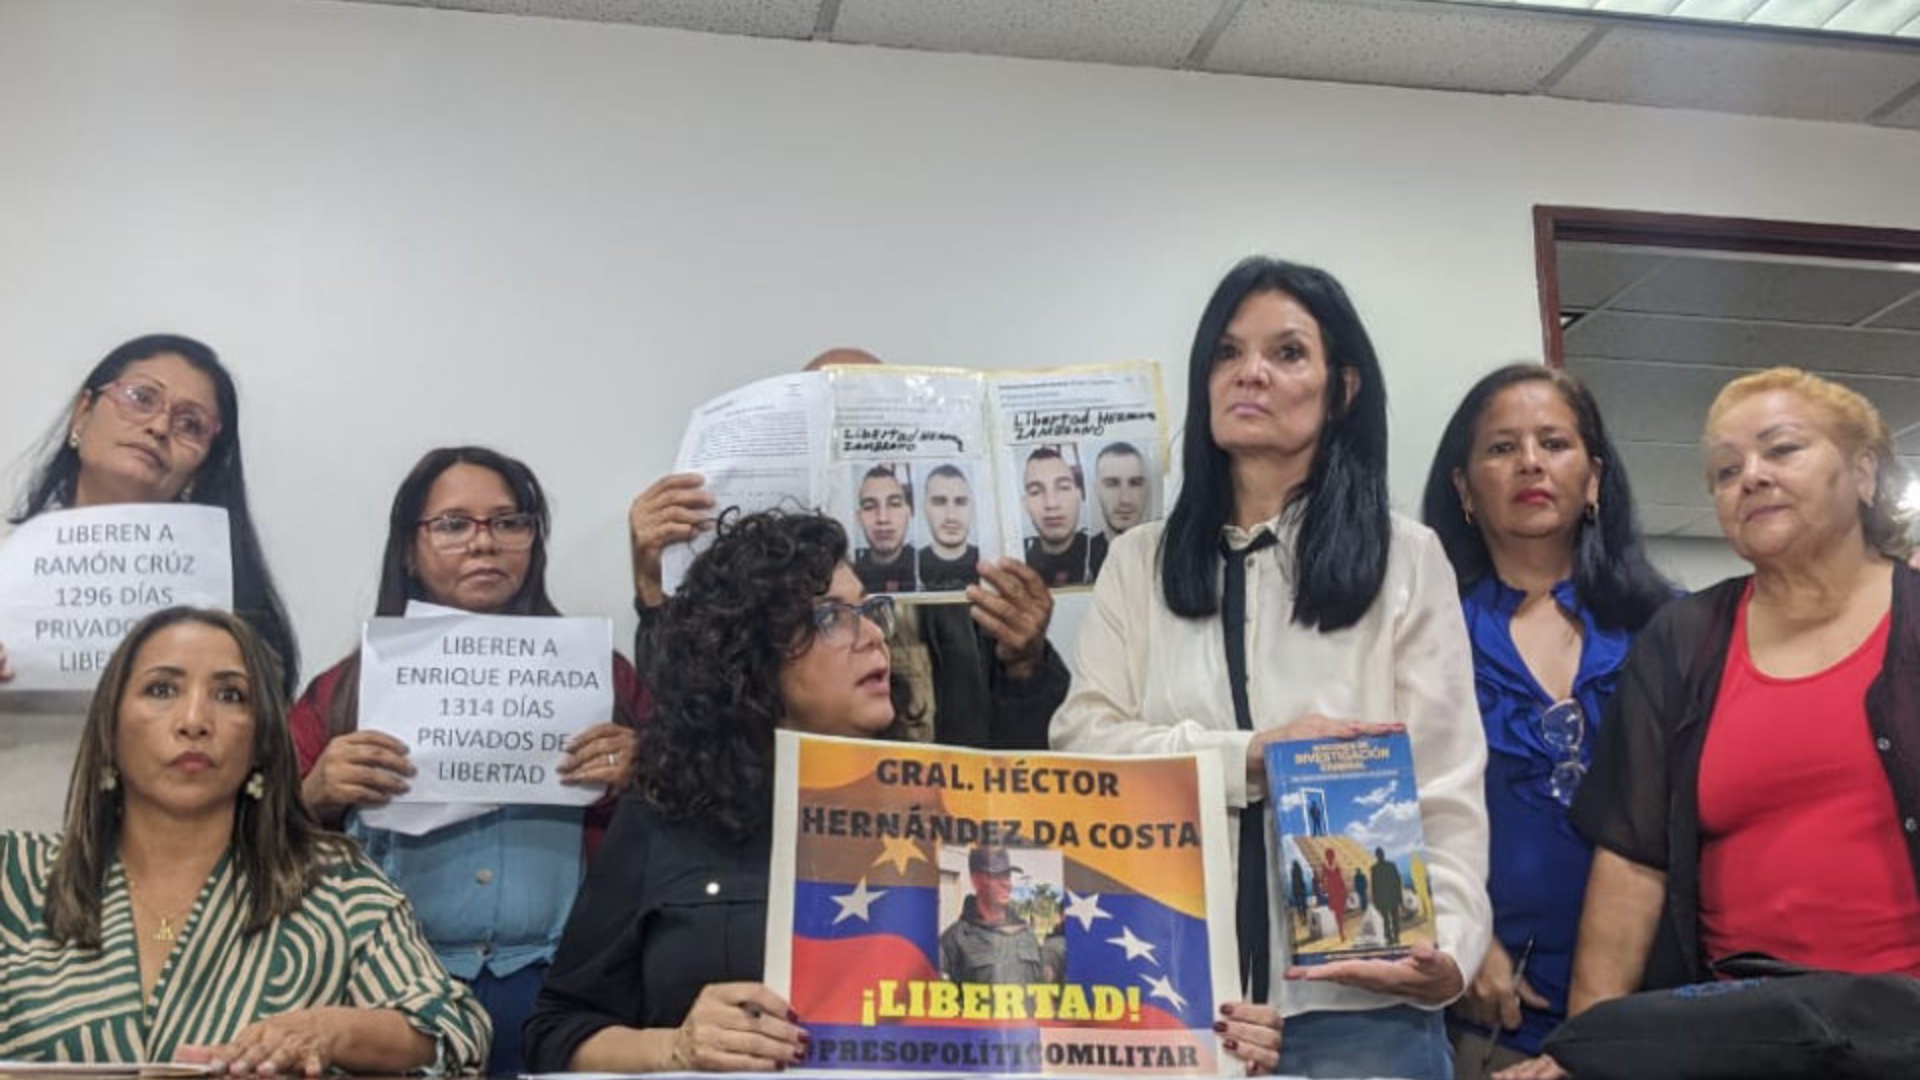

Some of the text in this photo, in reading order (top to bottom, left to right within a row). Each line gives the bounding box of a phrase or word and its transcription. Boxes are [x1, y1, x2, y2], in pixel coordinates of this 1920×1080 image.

[56, 523, 174, 545] LIBEREN A
[33, 550, 196, 576] RAMÓN CRÚZ
[55, 581, 174, 607] 1296 DÍAS
[443, 636, 559, 657] LIBEREN A
[396, 667, 600, 690] ENRIQUE PARADA
[438, 694, 556, 719] 1314 DÍAS
[417, 727, 572, 752] PRIVADOS DE
[438, 761, 546, 785] LIBERTAD
[876, 759, 1120, 798] GRAL. HÉCTOR
[801, 806, 1200, 850] HERNÁNDEZ DA COSTA
[861, 980, 1141, 1027] ¡LIBERTAD!
